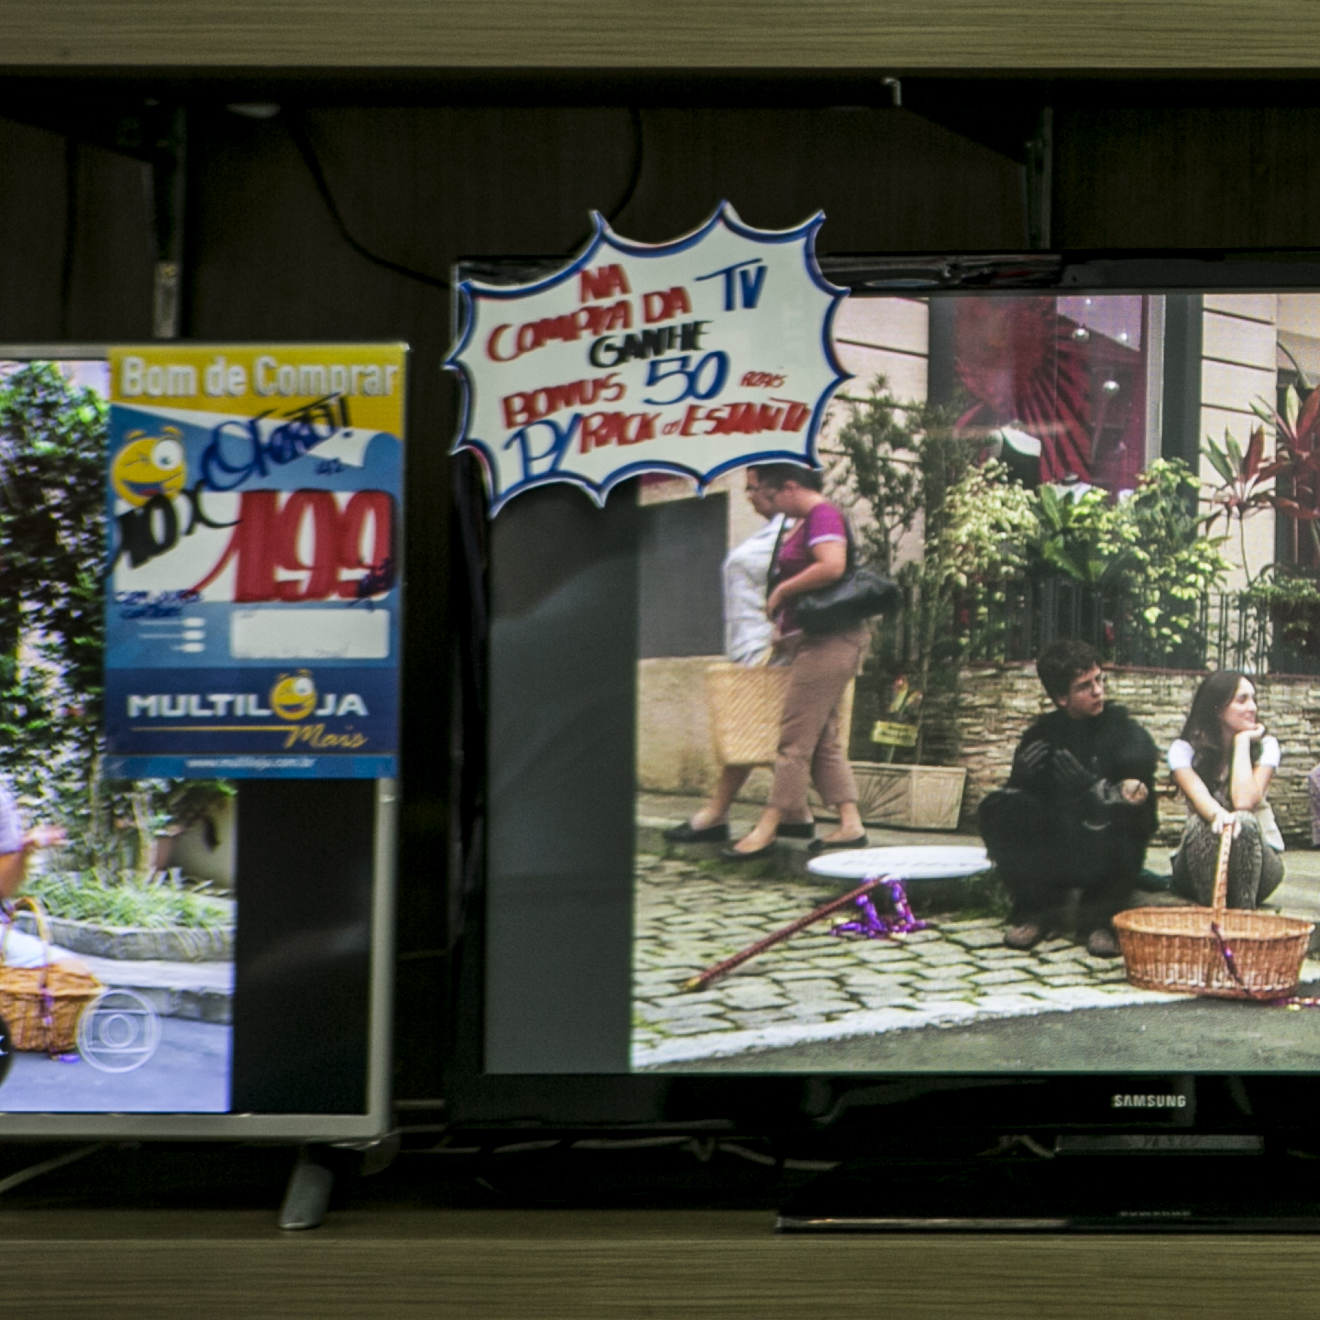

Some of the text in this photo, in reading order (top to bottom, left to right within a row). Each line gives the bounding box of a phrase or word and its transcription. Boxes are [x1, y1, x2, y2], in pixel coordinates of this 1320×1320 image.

[579, 263, 631, 304] NA
[485, 258, 768, 361] COMPRA DA TV
[588, 320, 713, 368] GANHE
[121, 354, 399, 401] Bom de Comprar
[502, 373, 627, 430] BONUS
[642, 350, 731, 406] 50
[1113, 1094, 1187, 1107] SAMSUNG
